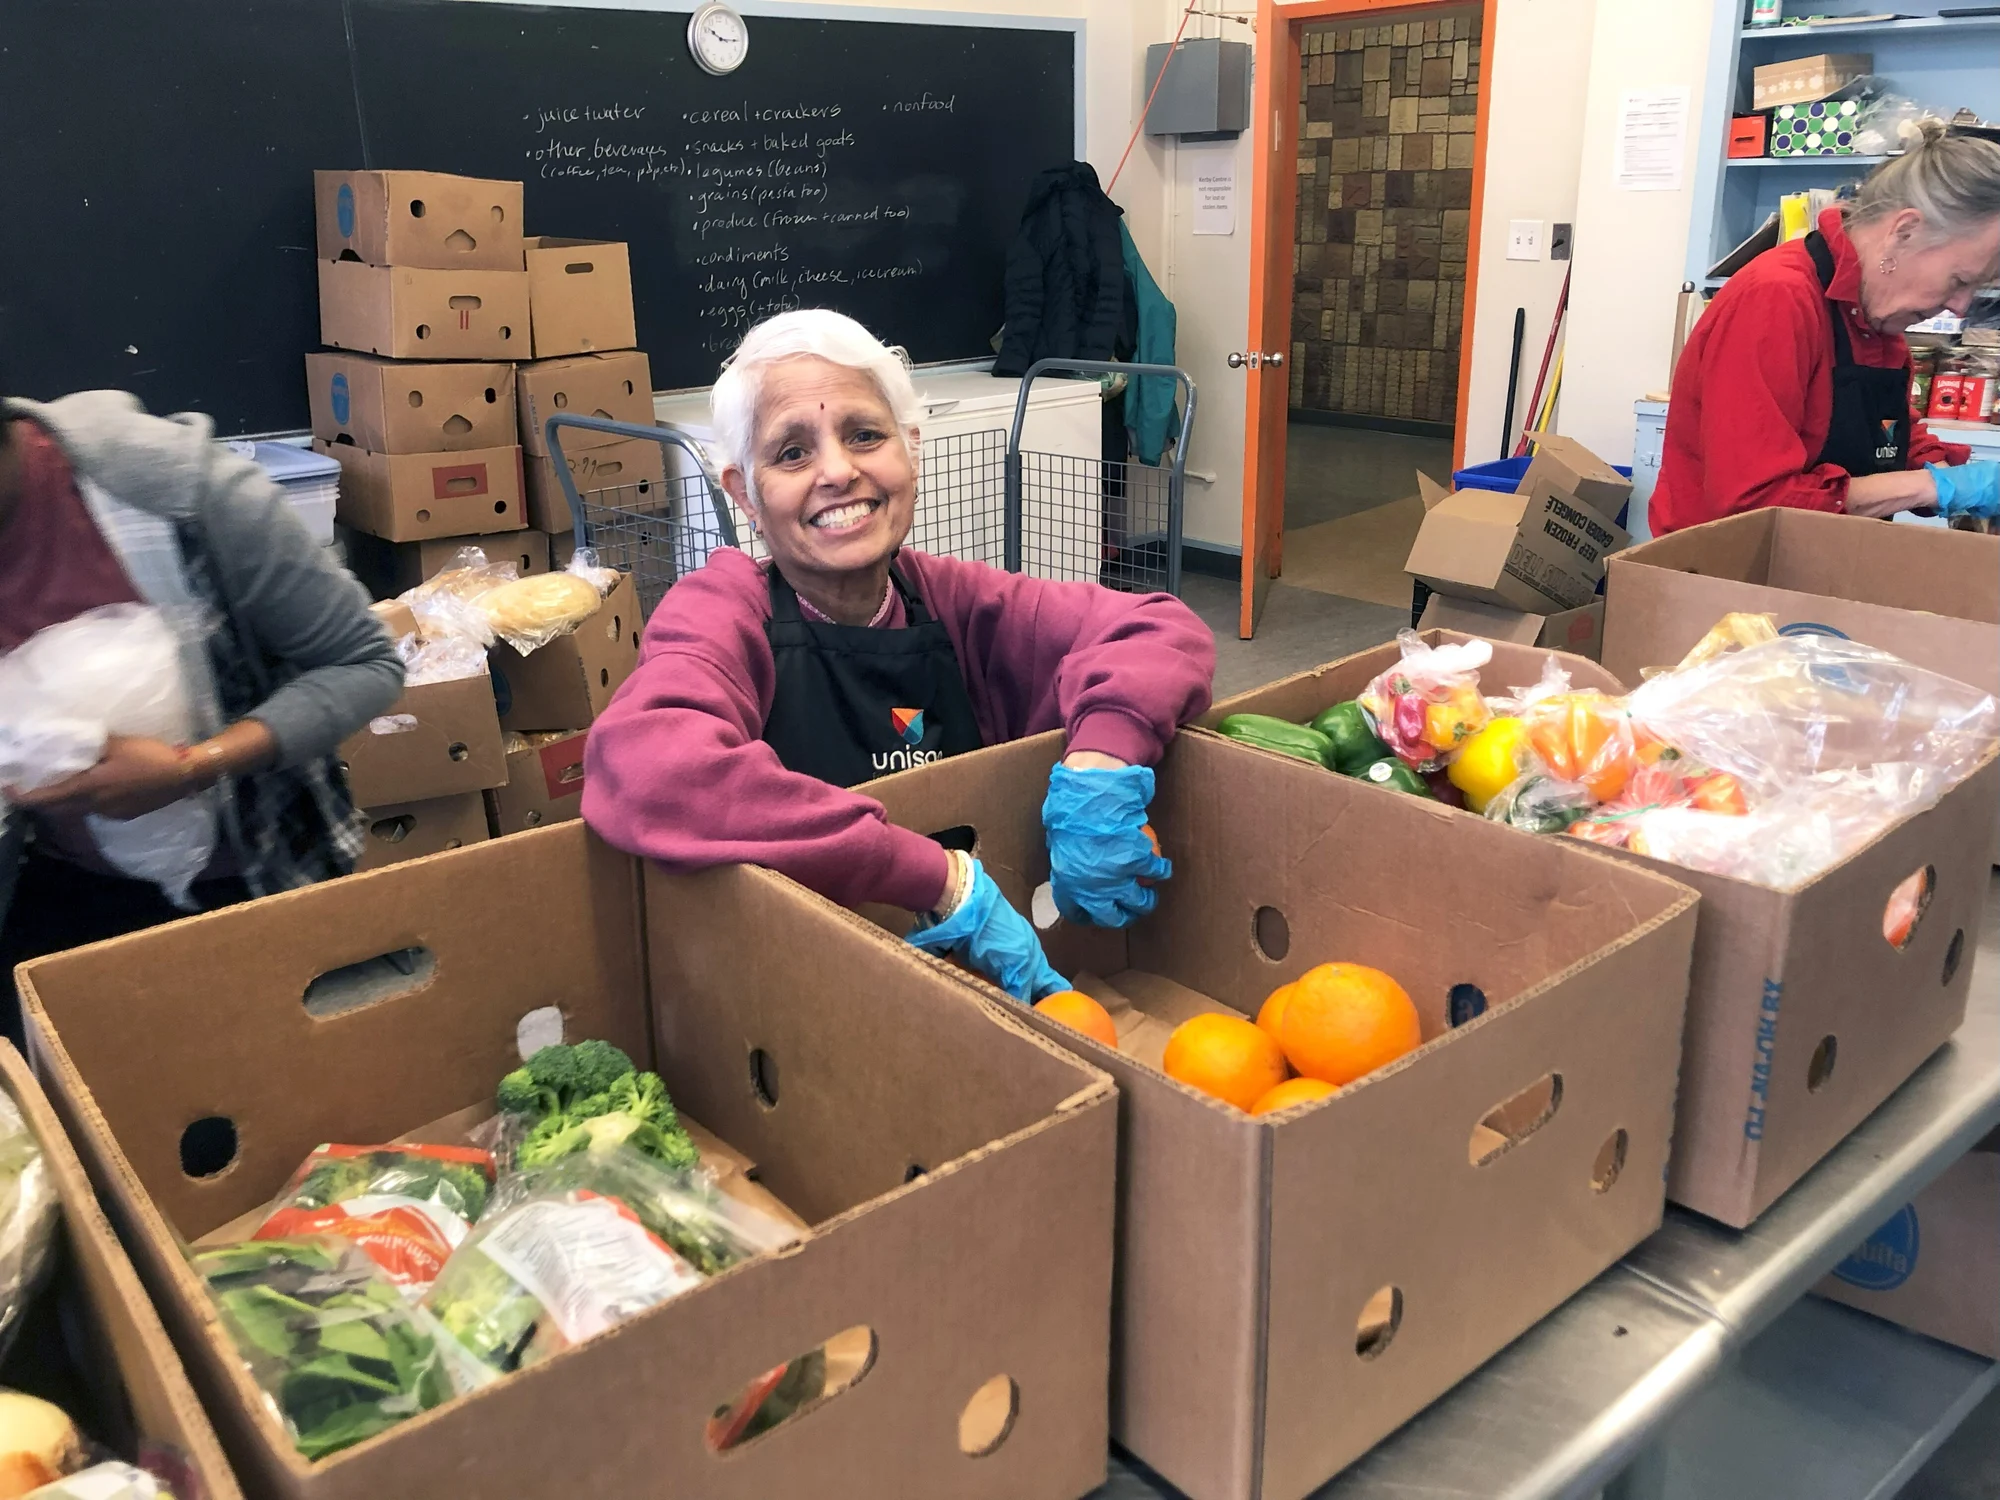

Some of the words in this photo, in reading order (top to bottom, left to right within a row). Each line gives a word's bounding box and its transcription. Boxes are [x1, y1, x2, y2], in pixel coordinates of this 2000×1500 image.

[536, 107, 579, 133] juice
[689, 100, 748, 124] cereal
[536, 138, 586, 160] other
[764, 132, 808, 151] baked
[696, 162, 763, 185] legumes
[701, 213, 758, 240] produce
[701, 242, 790, 266] condiments
[704, 273, 748, 300] dairy
[1543, 494, 1588, 530] CONGELÉ
[1543, 518, 1581, 551] FROZEN
[1578, 542, 1599, 564] KEEP
